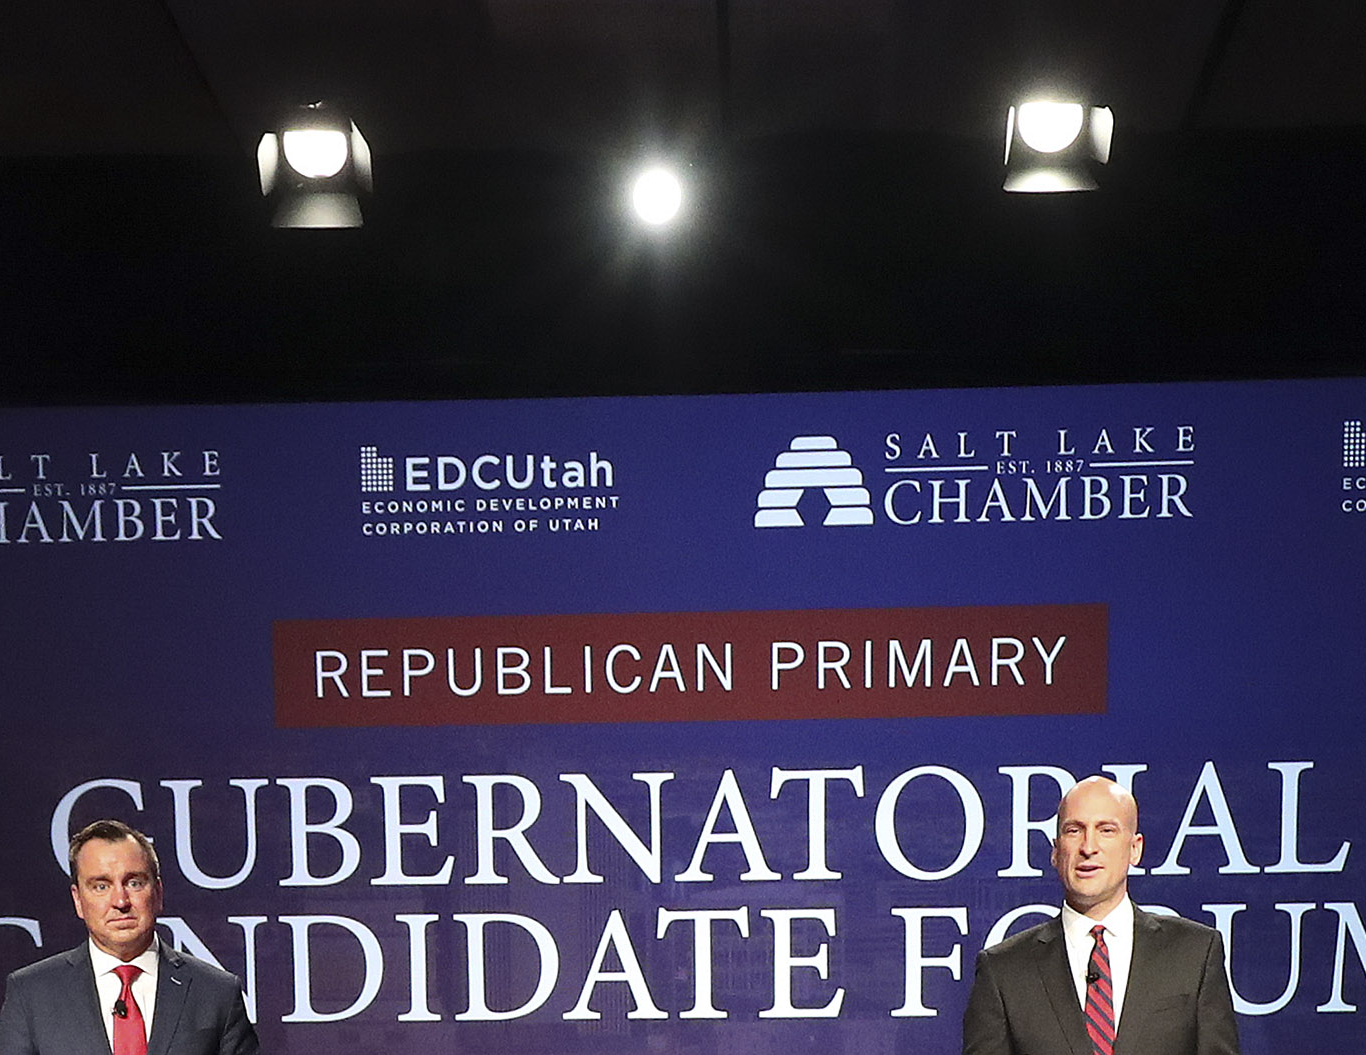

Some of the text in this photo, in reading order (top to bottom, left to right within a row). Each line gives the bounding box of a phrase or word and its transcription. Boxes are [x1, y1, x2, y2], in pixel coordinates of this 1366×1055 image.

[884, 426, 1195, 460] SALT LAKE
[89, 450, 221, 479] LAKE
[405, 451, 615, 492] EDCUtah
[996, 459, 1084, 474] EST. 1887
[33, 482, 116, 497] EST. 1887
[883, 474, 1194, 526] CHAMBER
[361, 496, 620, 514] ECONOMIC DEVELOPMENT
[362, 518, 600, 536] CORPORATION OF UTAH
[314, 636, 1067, 698] REPUBLICAN PRIMARY
